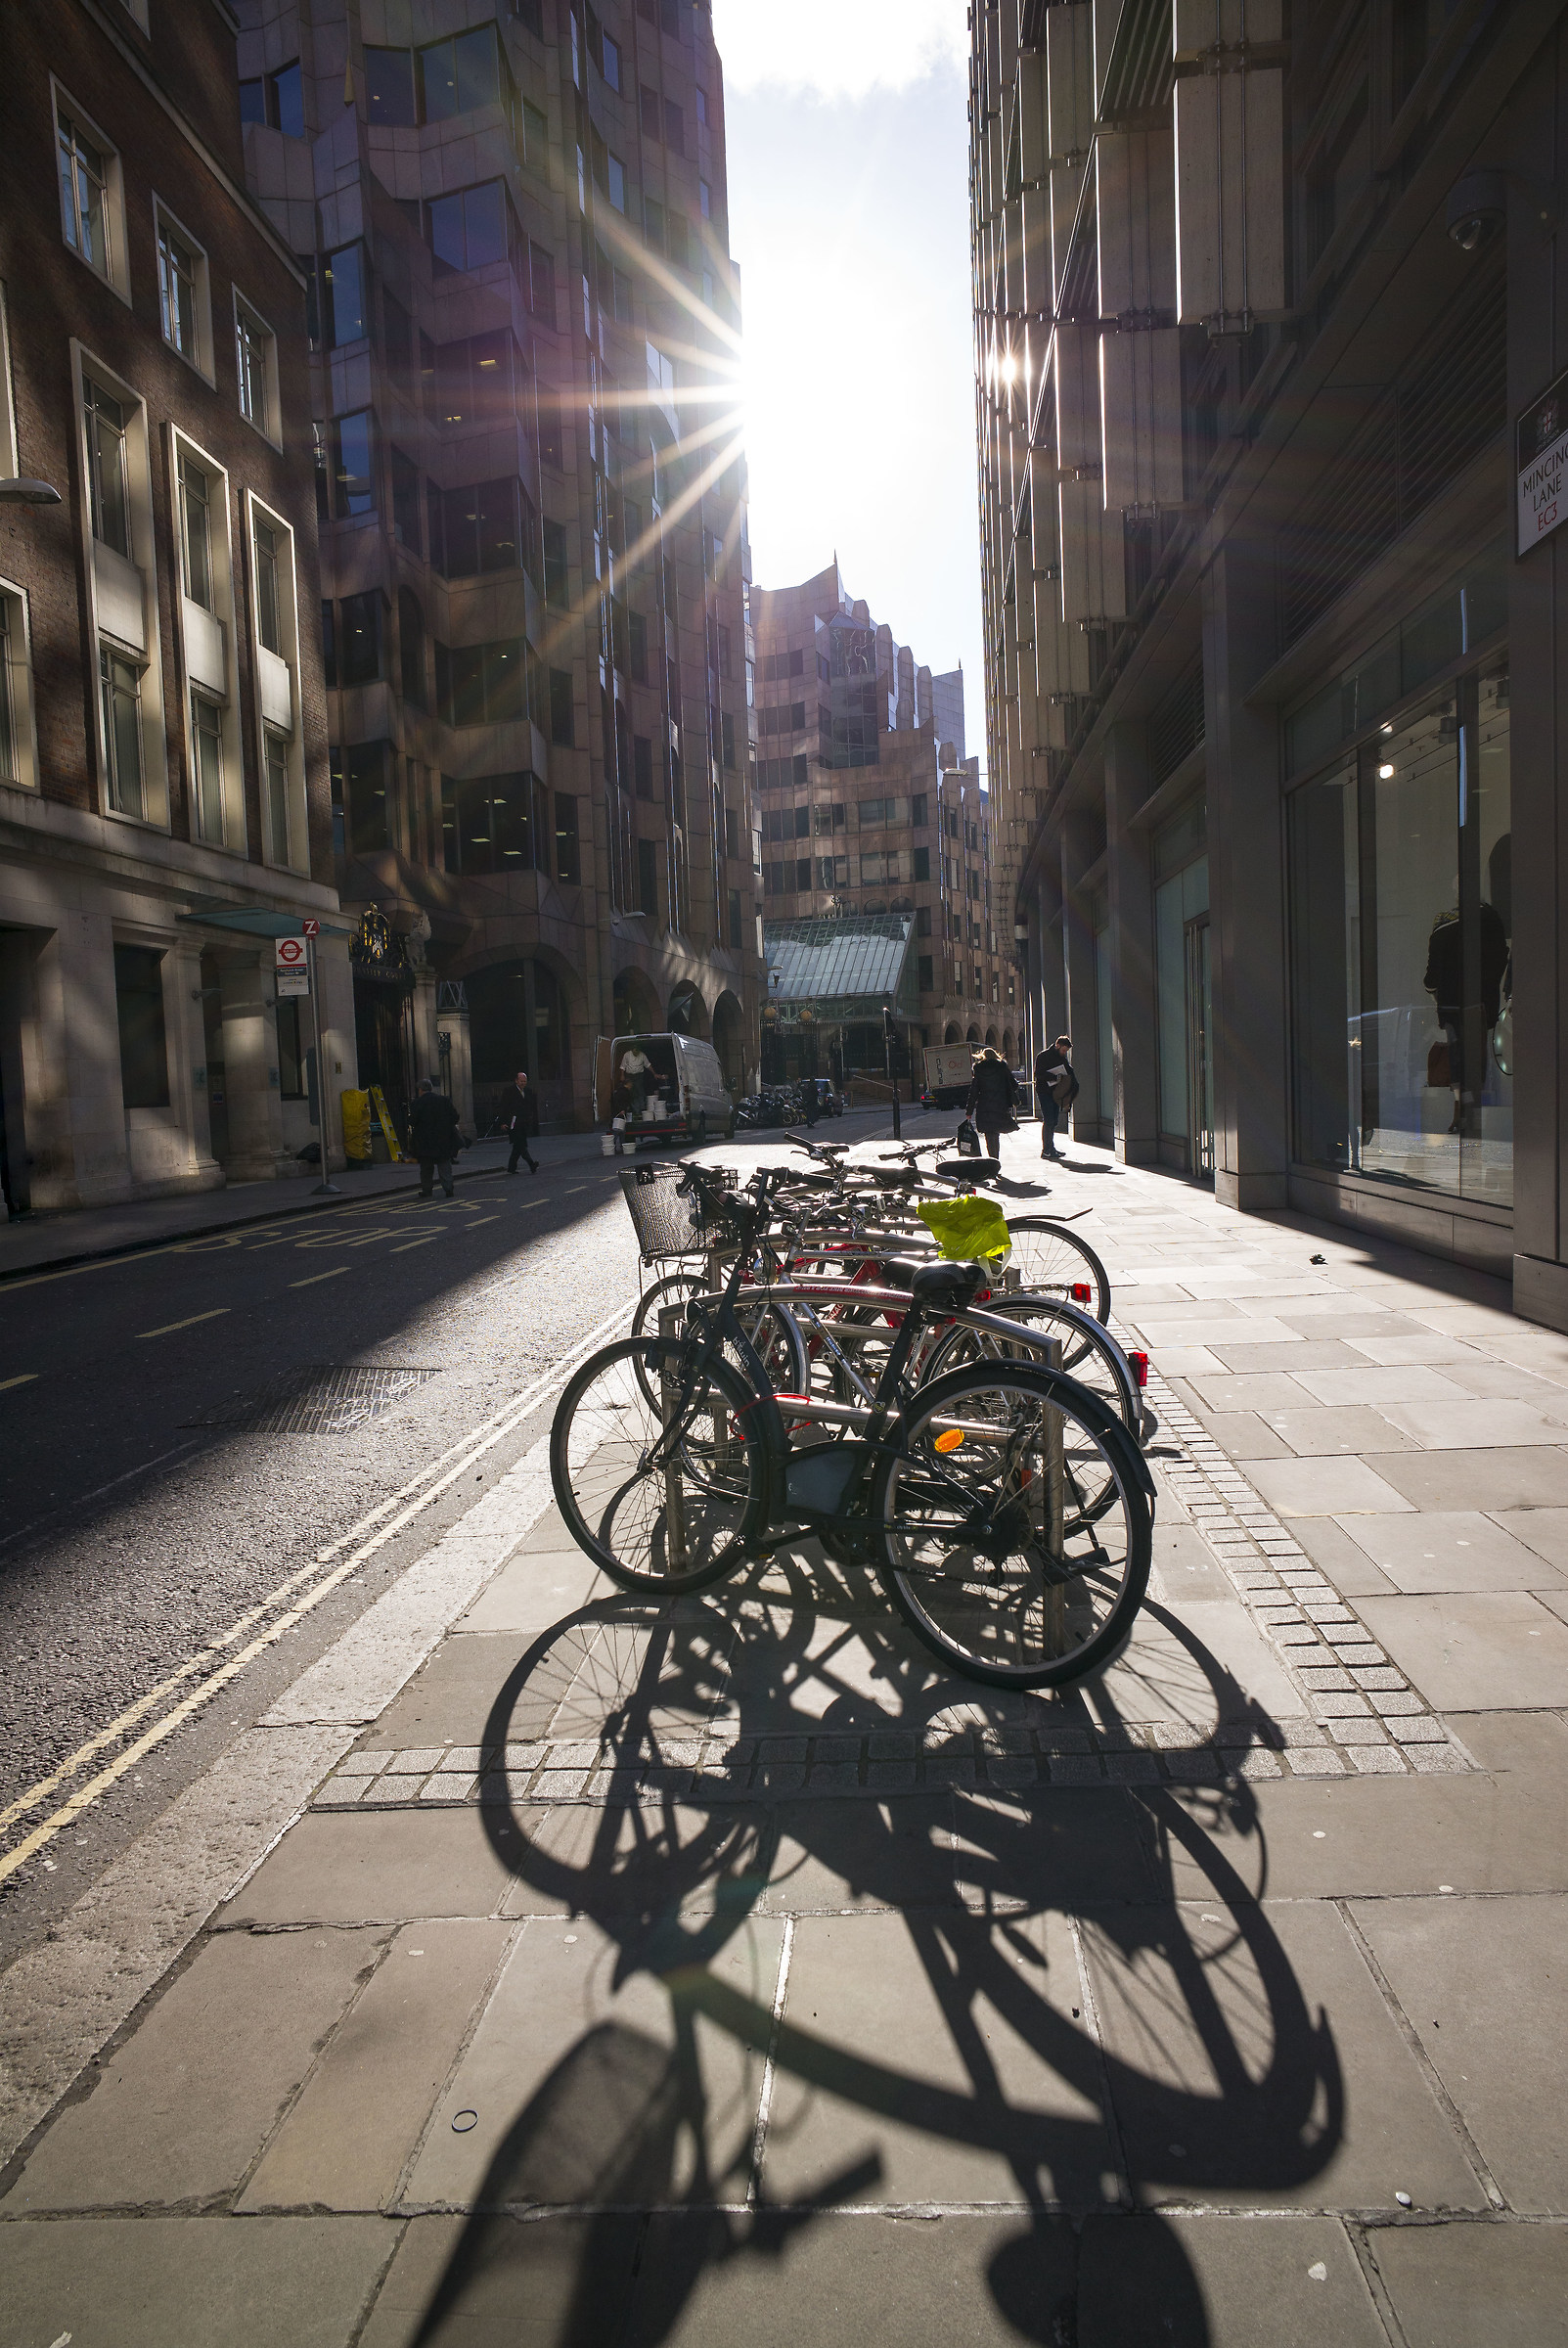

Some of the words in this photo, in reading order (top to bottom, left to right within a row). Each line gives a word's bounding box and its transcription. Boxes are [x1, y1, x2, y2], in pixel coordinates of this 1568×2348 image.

[1534, 473, 1562, 513] LANE
[1538, 501, 1557, 532] EC3
[305, 921, 316, 934] Z
[336, 1198, 507, 1216] BUS
[171, 1227, 448, 1252] STOP
